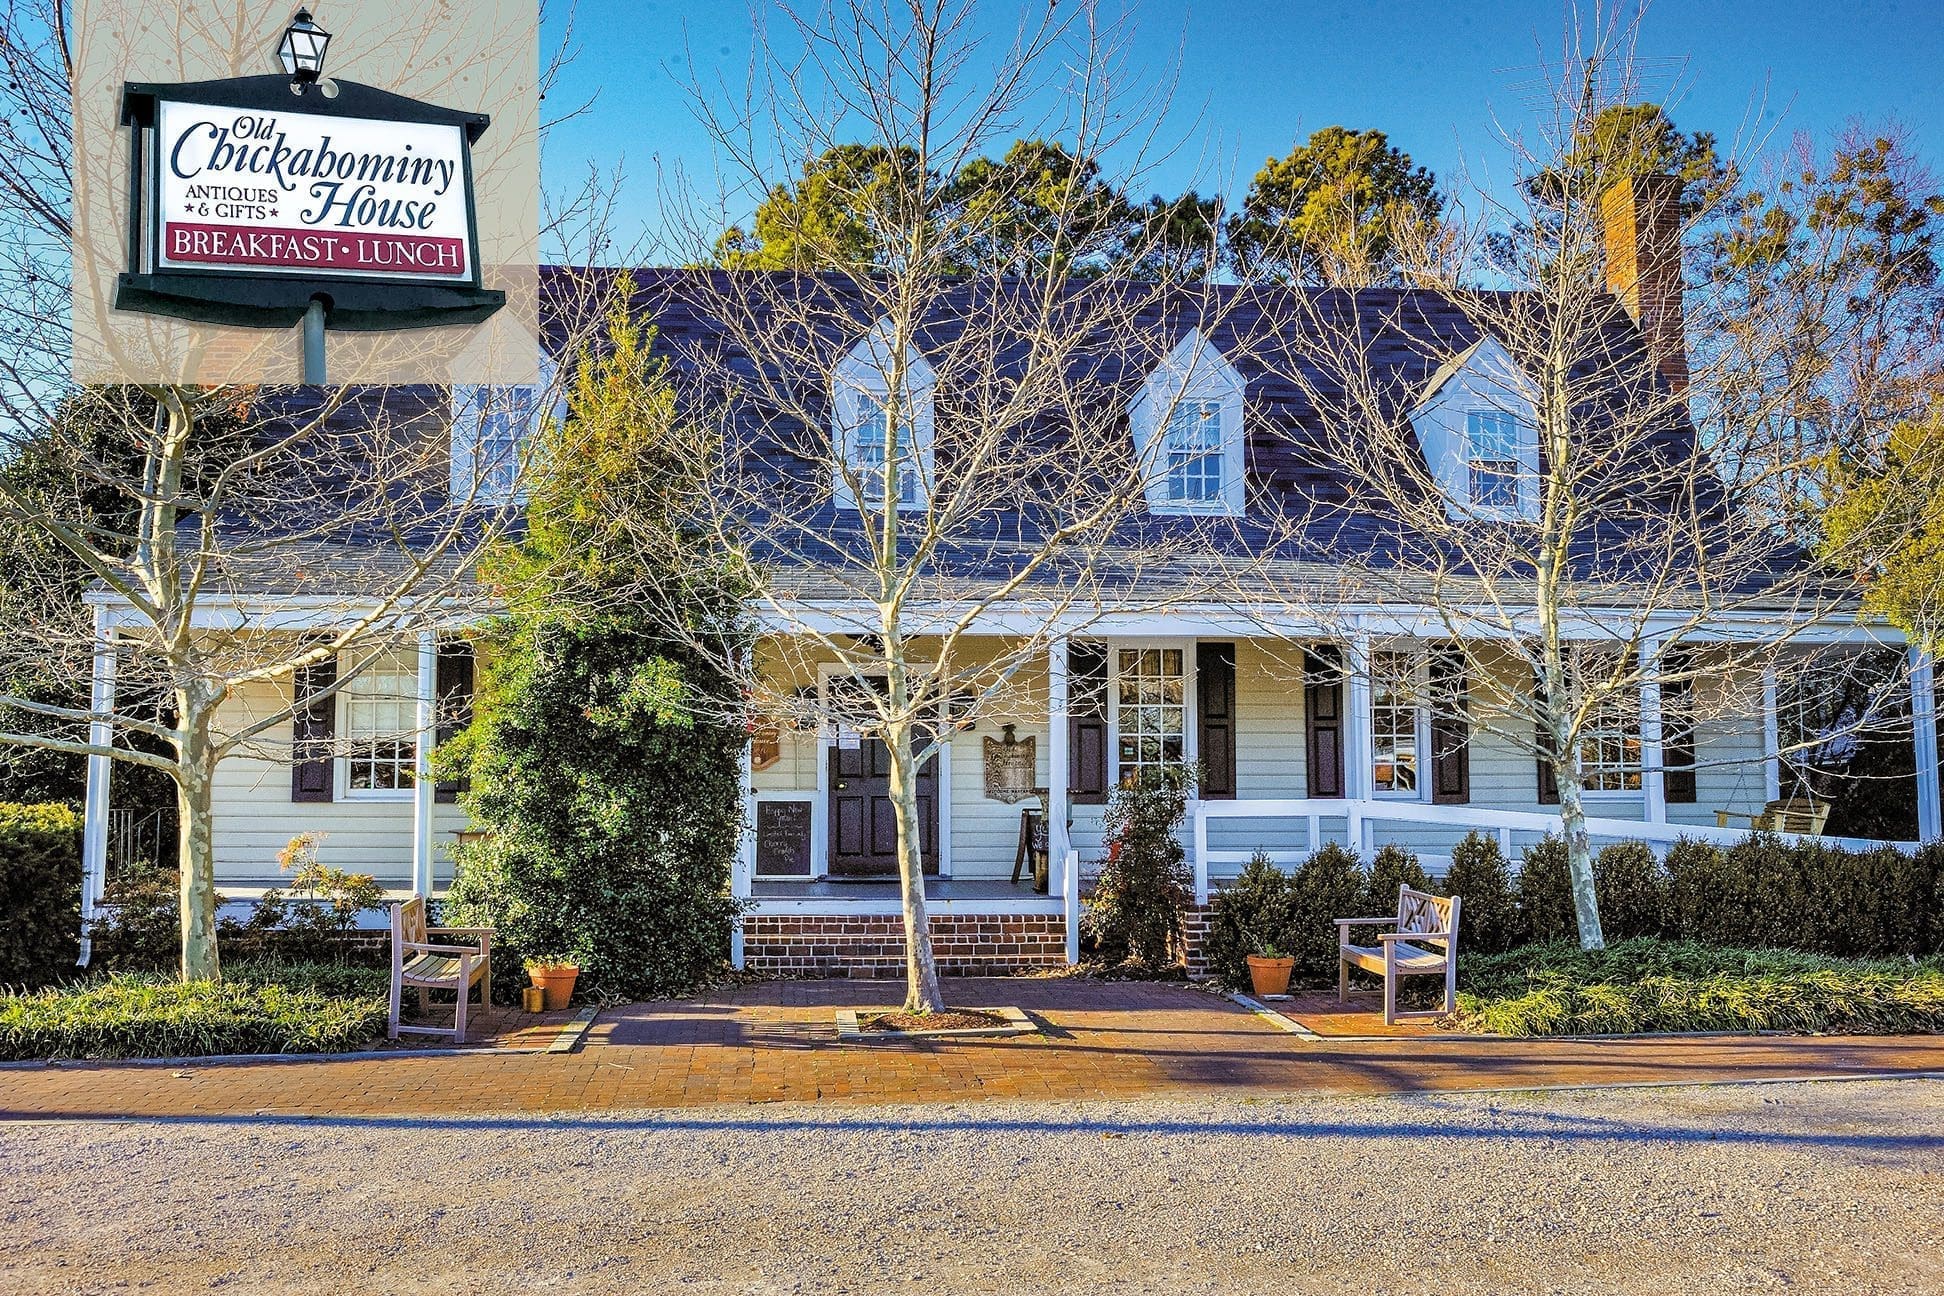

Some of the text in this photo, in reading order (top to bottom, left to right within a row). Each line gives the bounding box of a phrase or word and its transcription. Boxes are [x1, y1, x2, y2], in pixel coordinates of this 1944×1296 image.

[231, 115, 277, 141] Old
[170, 121, 456, 196] Chickahominy
[185, 184, 279, 204] ANTIQUES
[299, 180, 437, 230] House
[198, 202, 266, 220] & GIFTS
[173, 229, 459, 268] BREAKFAST LUNCH
